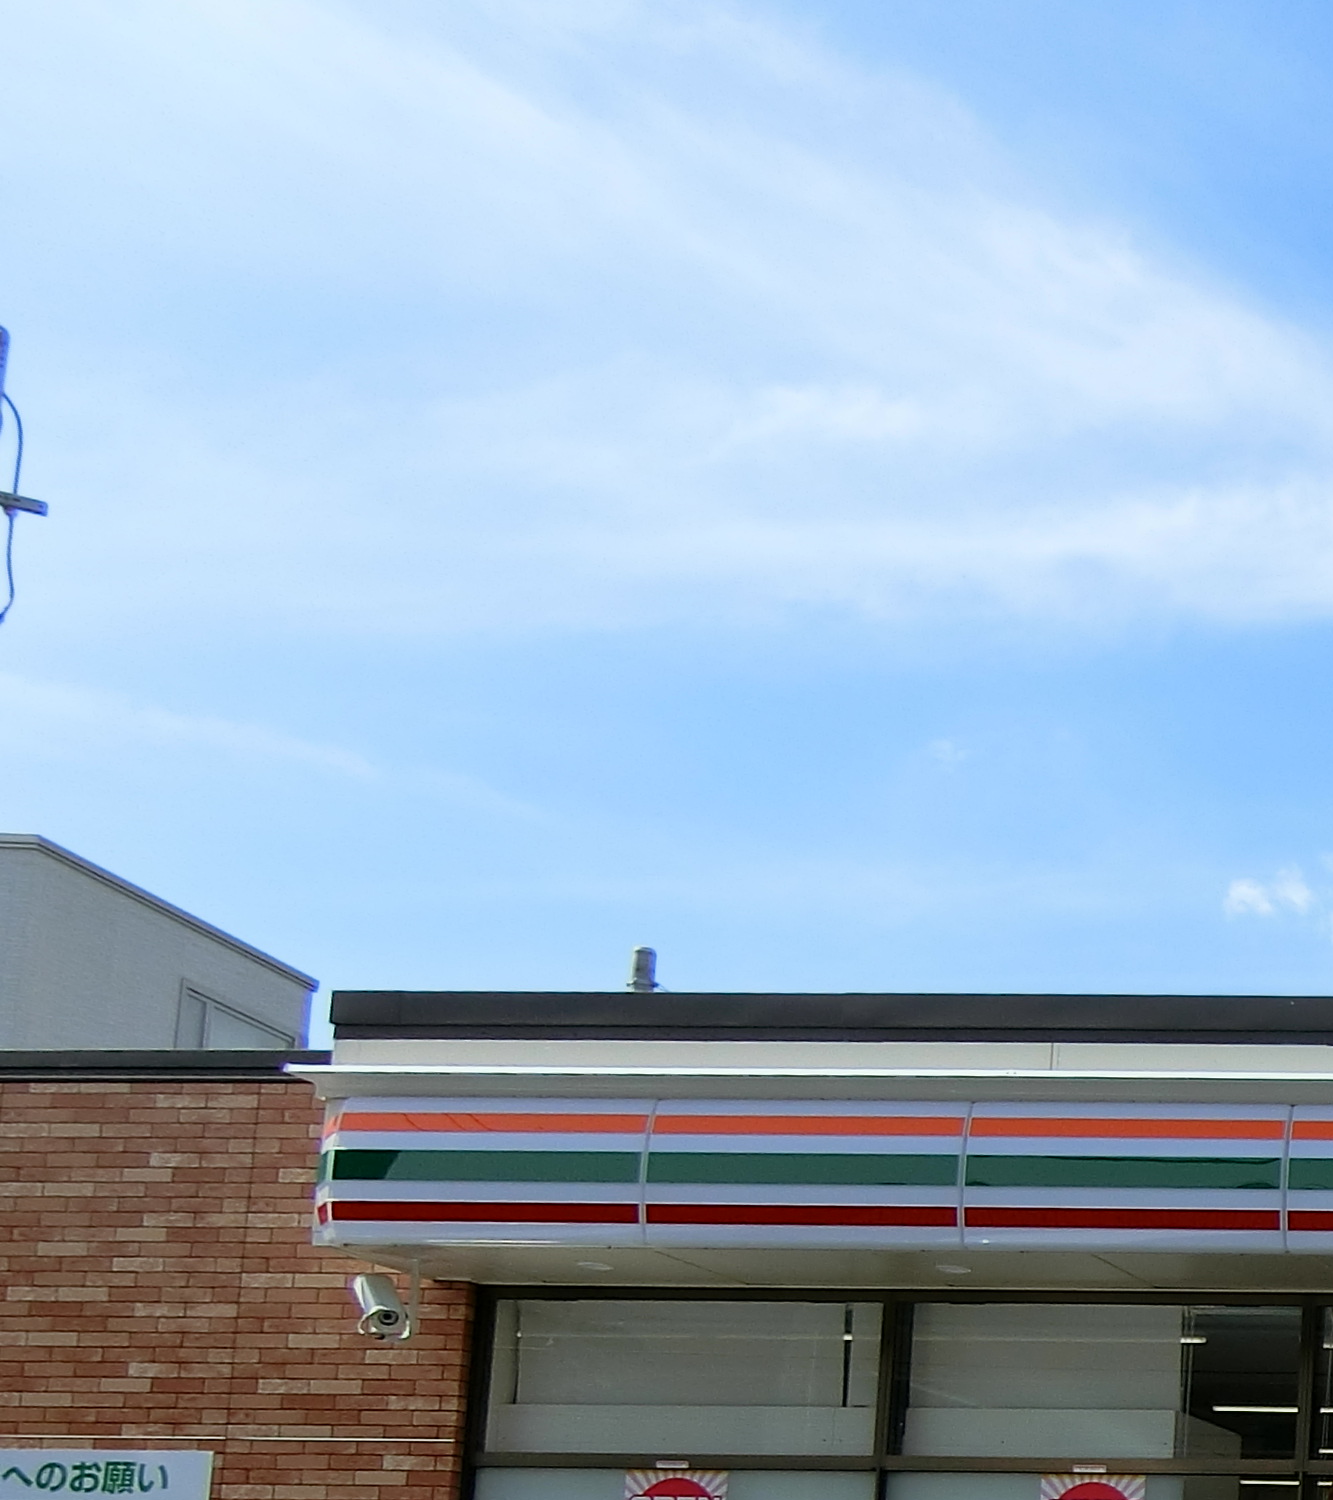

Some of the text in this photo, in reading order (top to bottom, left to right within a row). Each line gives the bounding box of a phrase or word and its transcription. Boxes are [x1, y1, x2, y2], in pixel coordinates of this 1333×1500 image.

[2, 1461, 169, 1494] へのお願い
